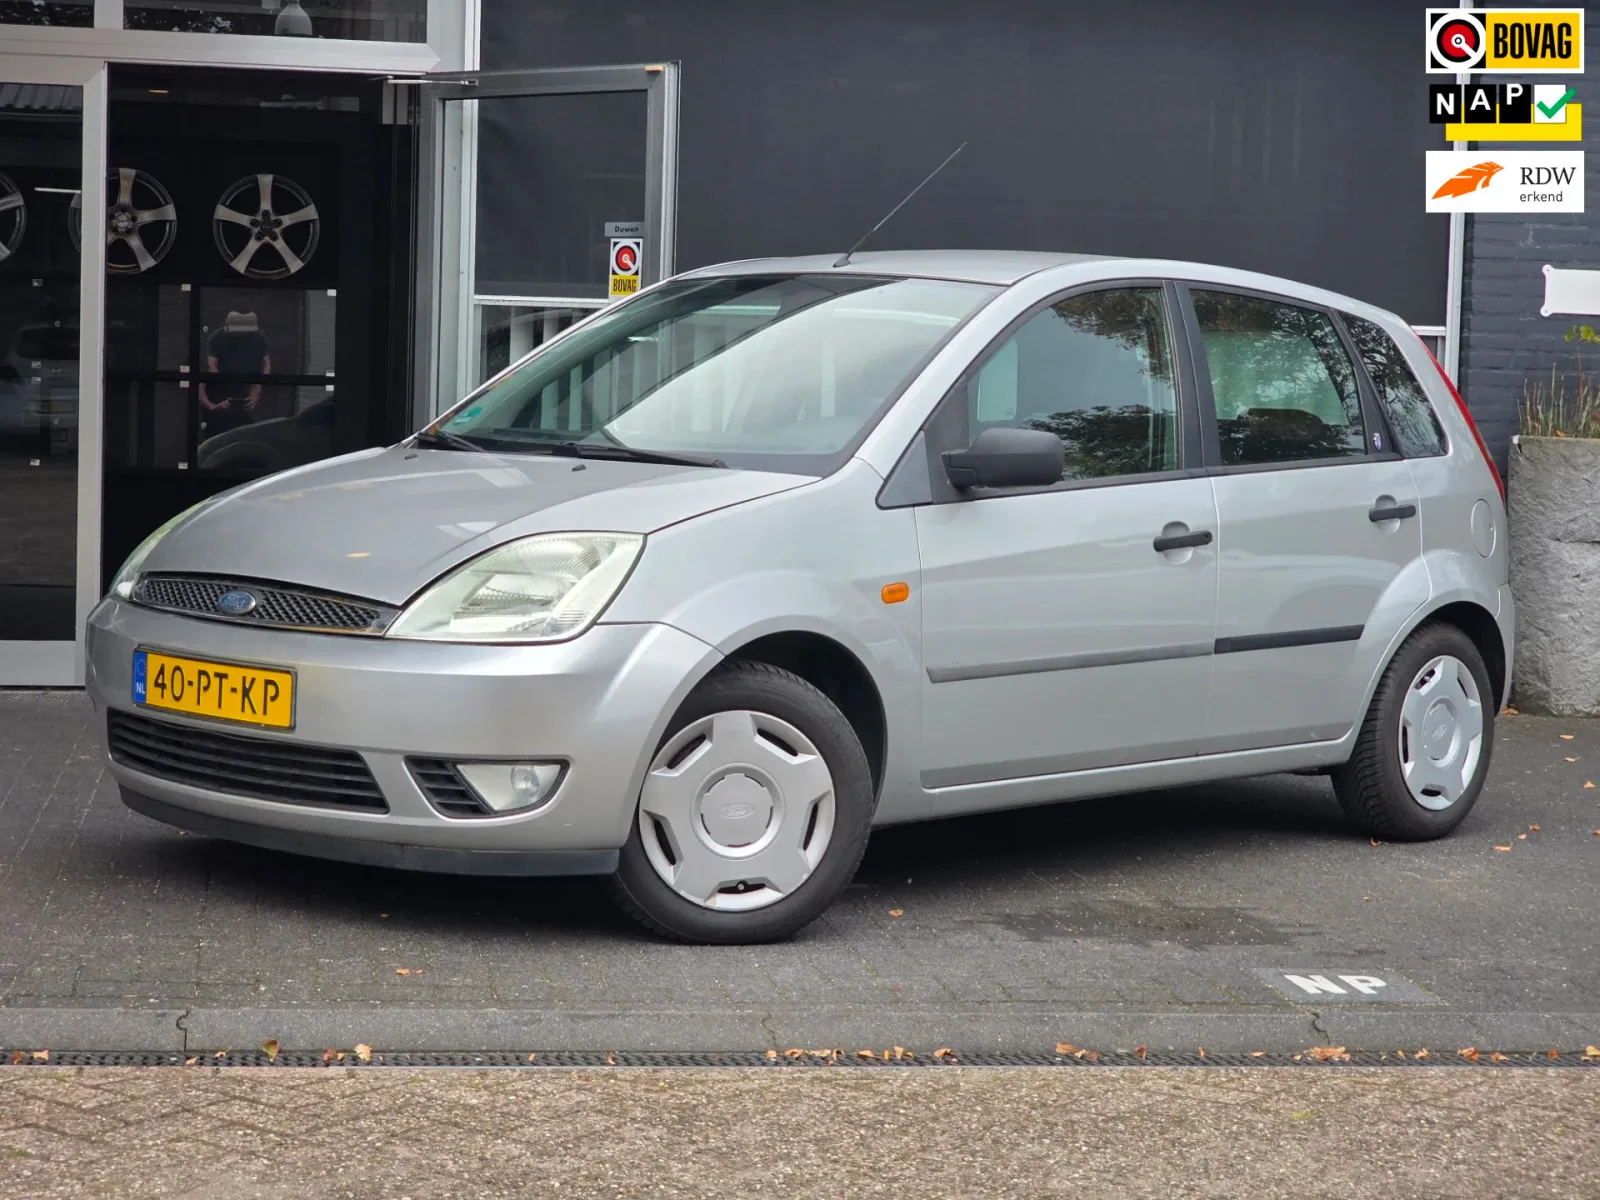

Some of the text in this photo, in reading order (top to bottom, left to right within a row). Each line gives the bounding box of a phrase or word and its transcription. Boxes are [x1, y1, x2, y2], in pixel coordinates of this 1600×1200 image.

[614, 225, 639, 233] Duwen
[613, 278, 637, 293] BOVAG
[136, 682, 146, 694] NL
[153, 662, 280, 717] 40-PT-KP
[1283, 974, 1387, 995] NP
